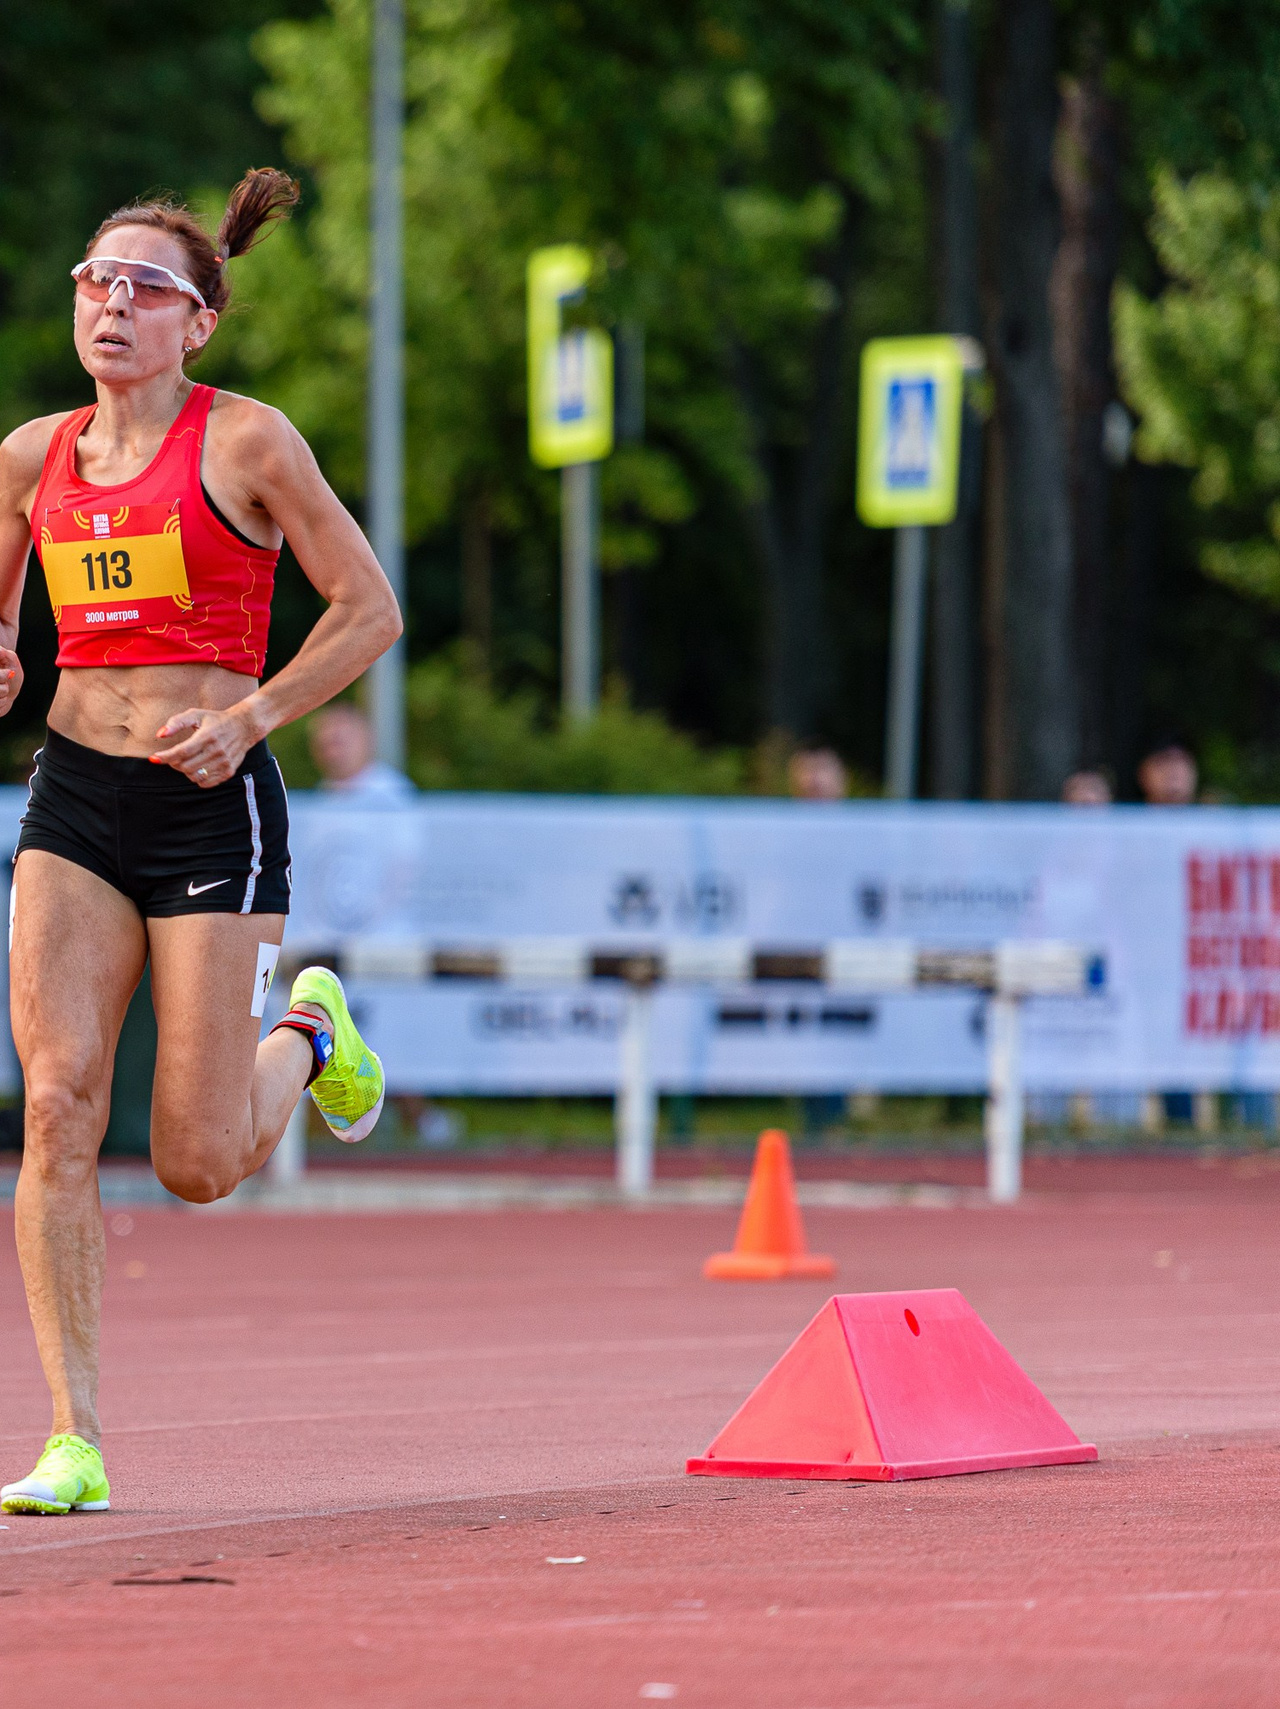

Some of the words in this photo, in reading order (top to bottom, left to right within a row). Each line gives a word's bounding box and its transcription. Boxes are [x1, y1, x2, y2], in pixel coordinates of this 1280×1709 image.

[81, 550, 132, 591] 113
[85, 611, 105, 623] 3000
[106, 610, 139, 622] метров
